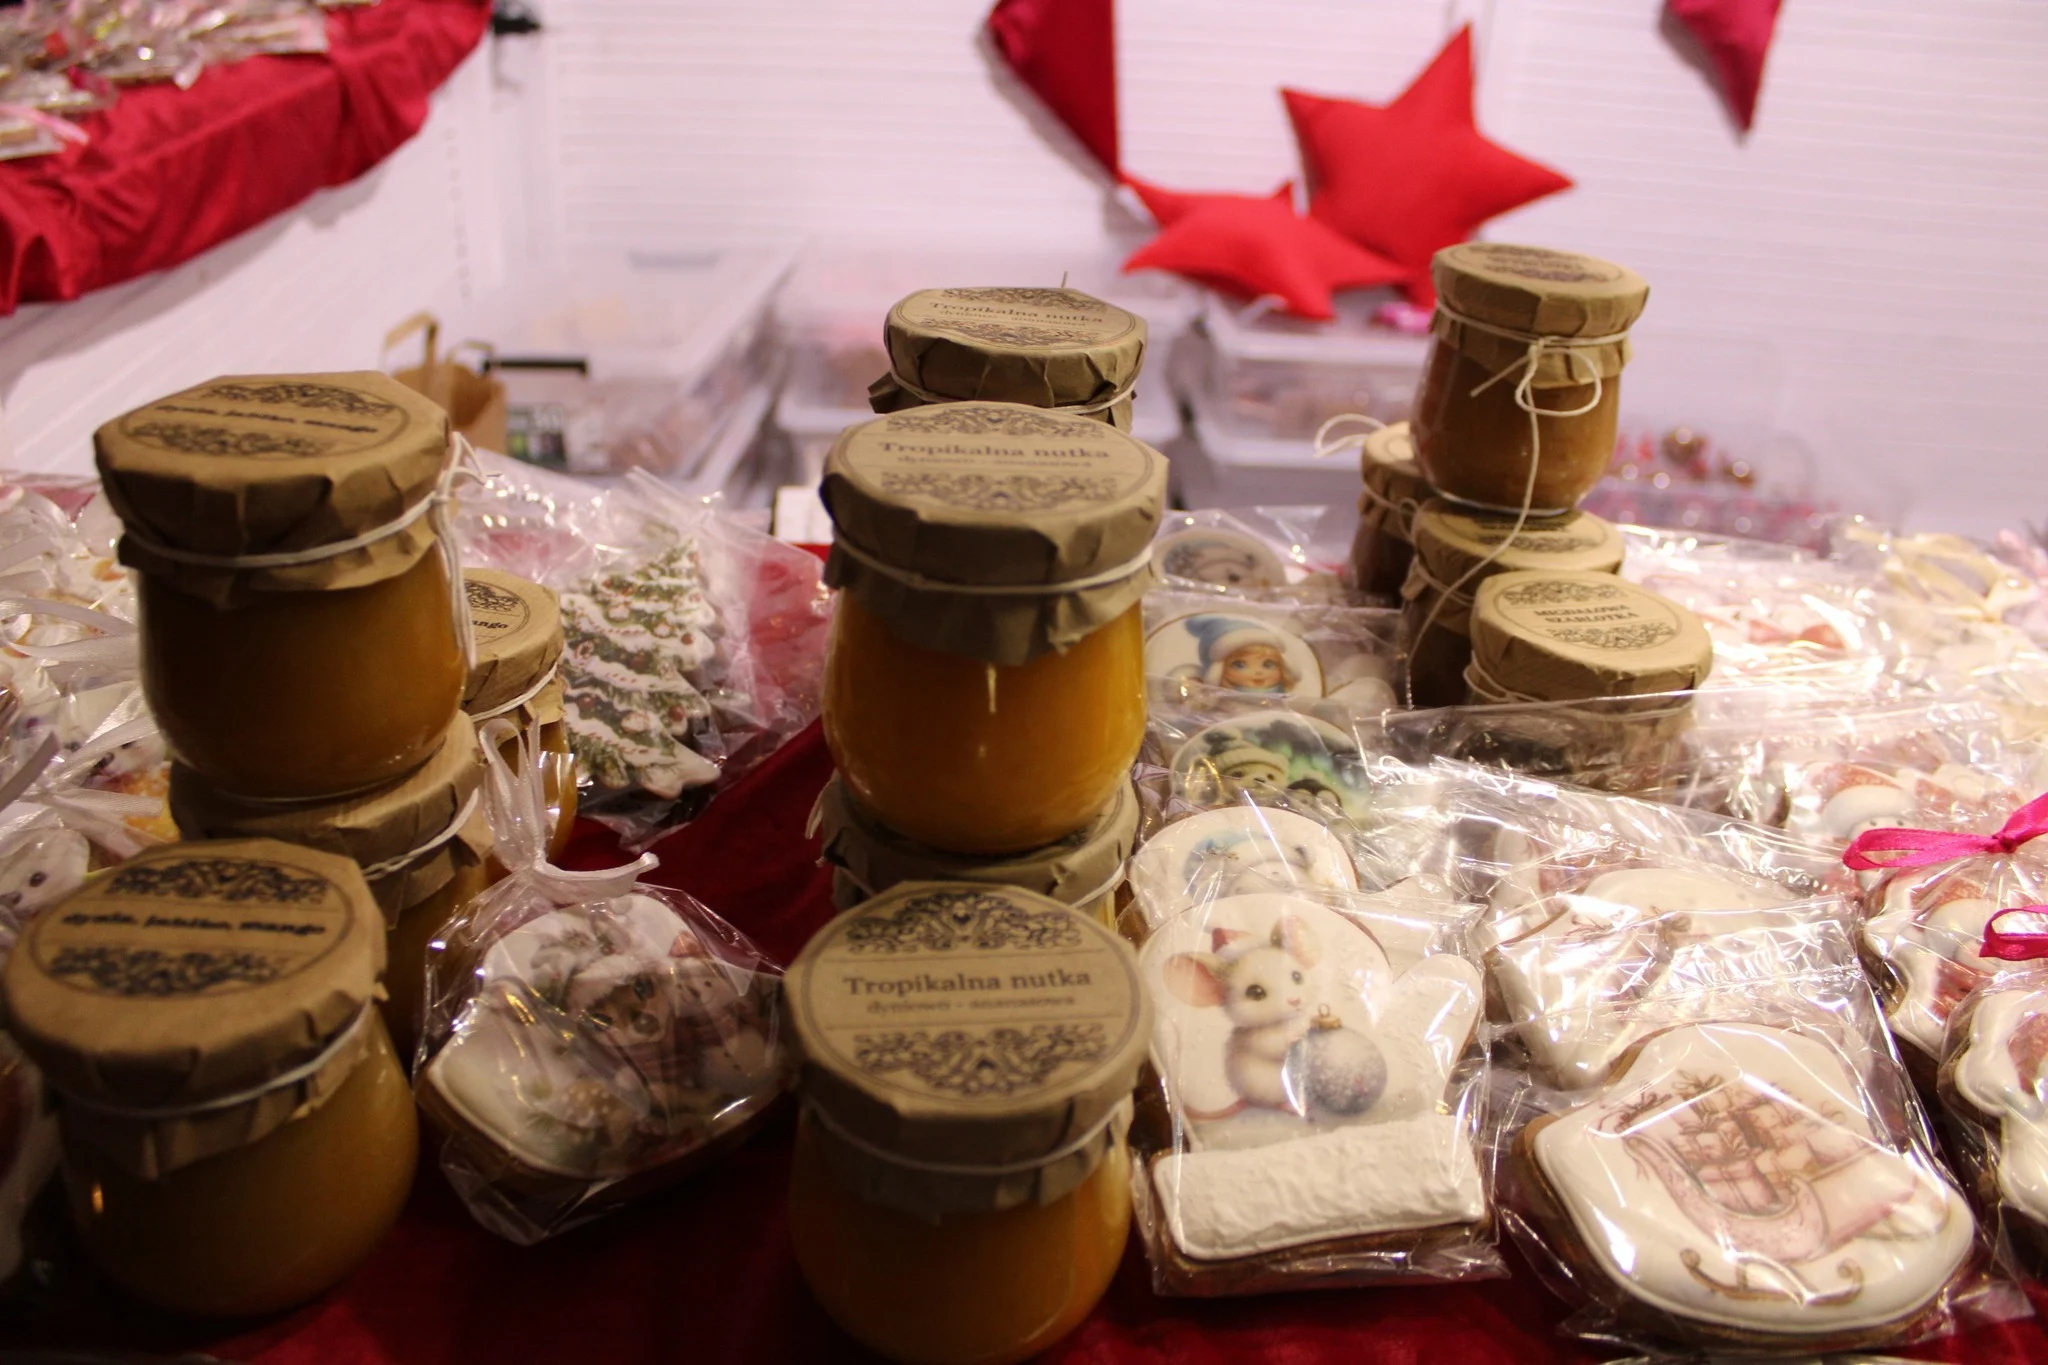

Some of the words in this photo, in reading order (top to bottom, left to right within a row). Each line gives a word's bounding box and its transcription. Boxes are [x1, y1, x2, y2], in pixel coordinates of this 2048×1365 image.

[930, 302, 1038, 317] Tropikalna
[1046, 314, 1103, 323] nutka
[878, 442, 1025, 456] Tropikalna
[1034, 448, 1109, 458] nutka
[472, 620, 508, 629] ango
[842, 972, 1001, 997] Tropikalna
[1010, 968, 1092, 990] nutka
